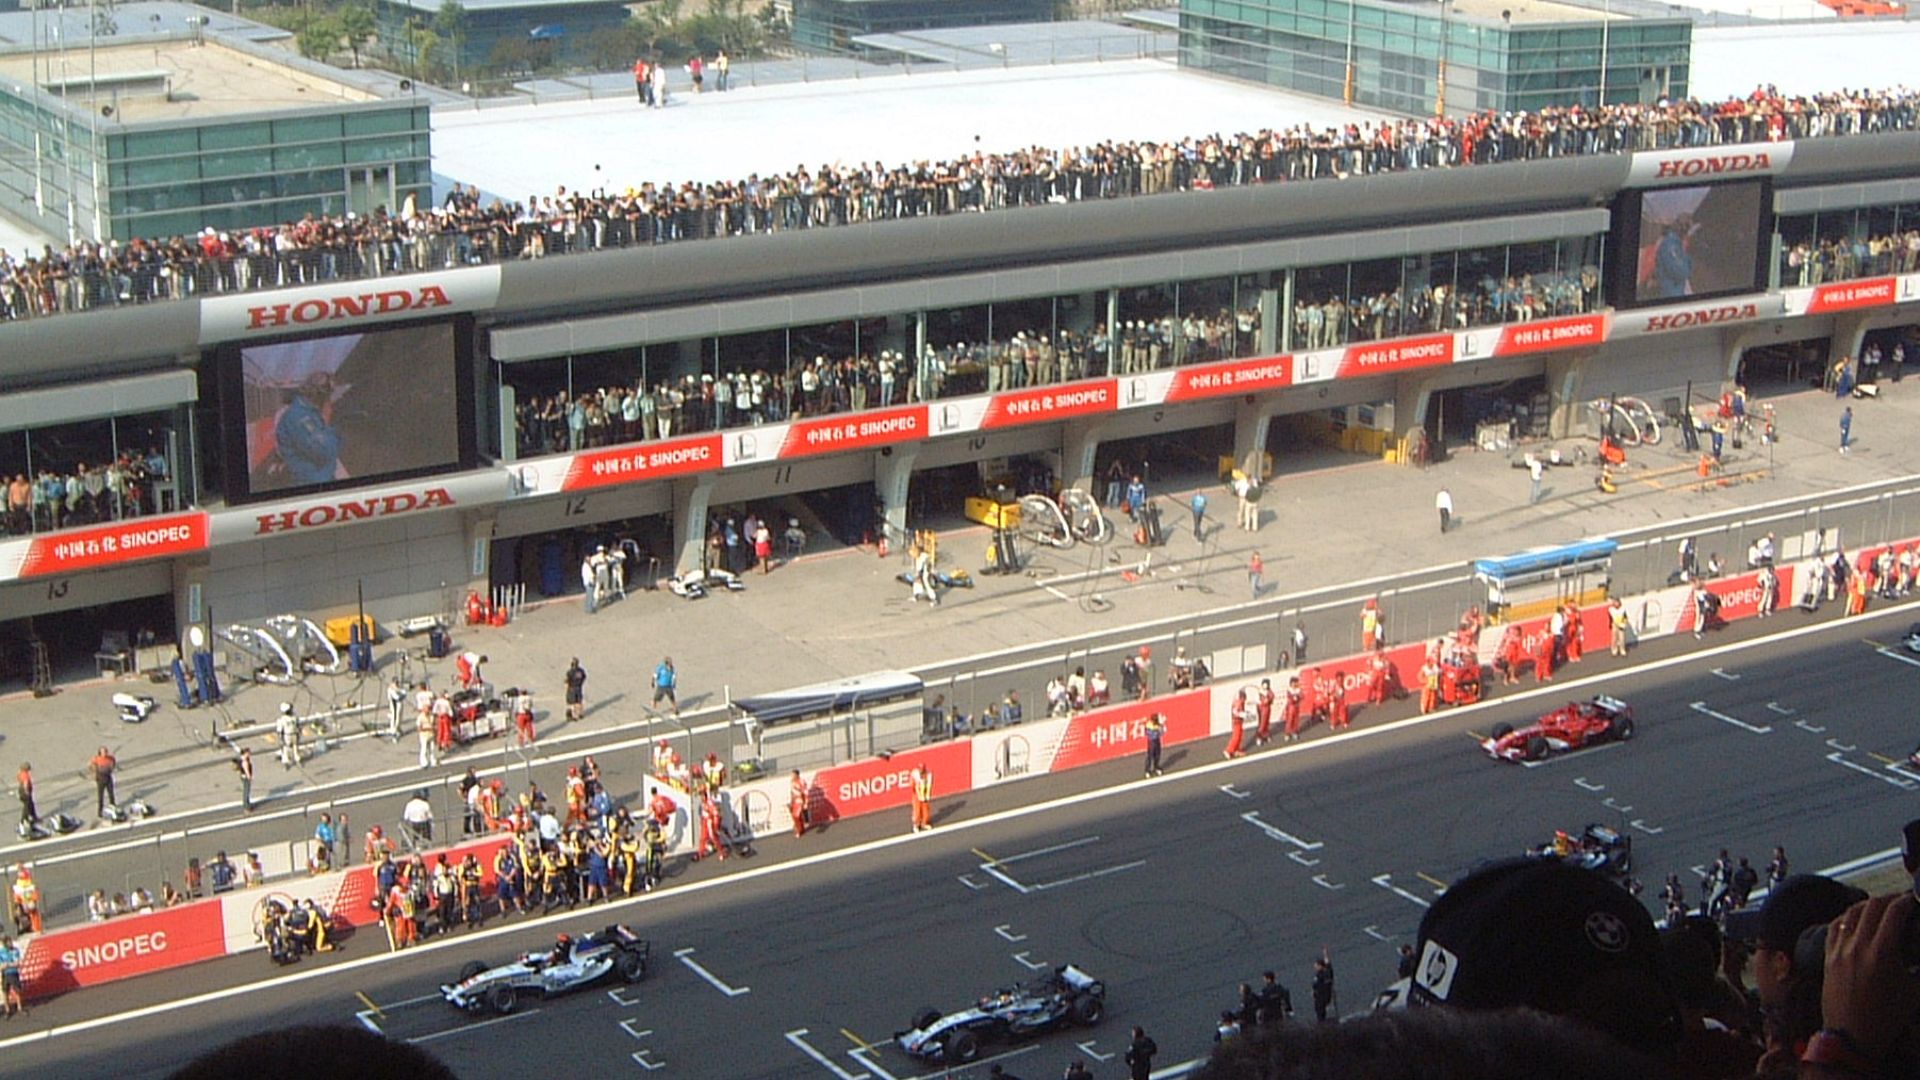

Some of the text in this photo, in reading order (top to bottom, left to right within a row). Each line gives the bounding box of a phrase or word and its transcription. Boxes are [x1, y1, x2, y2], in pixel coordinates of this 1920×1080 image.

[1655, 153, 1771, 179] HONDA
[246, 285, 452, 330] HONDA
[1643, 304, 1757, 332] HONDA
[1235, 365, 1282, 383] SINOPEC
[1056, 389, 1107, 408] SINOPEC
[860, 416, 916, 436] SINOPEC
[650, 446, 710, 467] SINOPEC
[255, 487, 455, 535] HONDA
[121, 525, 190, 549] SINOPEC
[1718, 586, 1761, 608] NOPEC
[839, 769, 914, 801] SINOPE
[61, 931, 167, 971] SINOPEC
